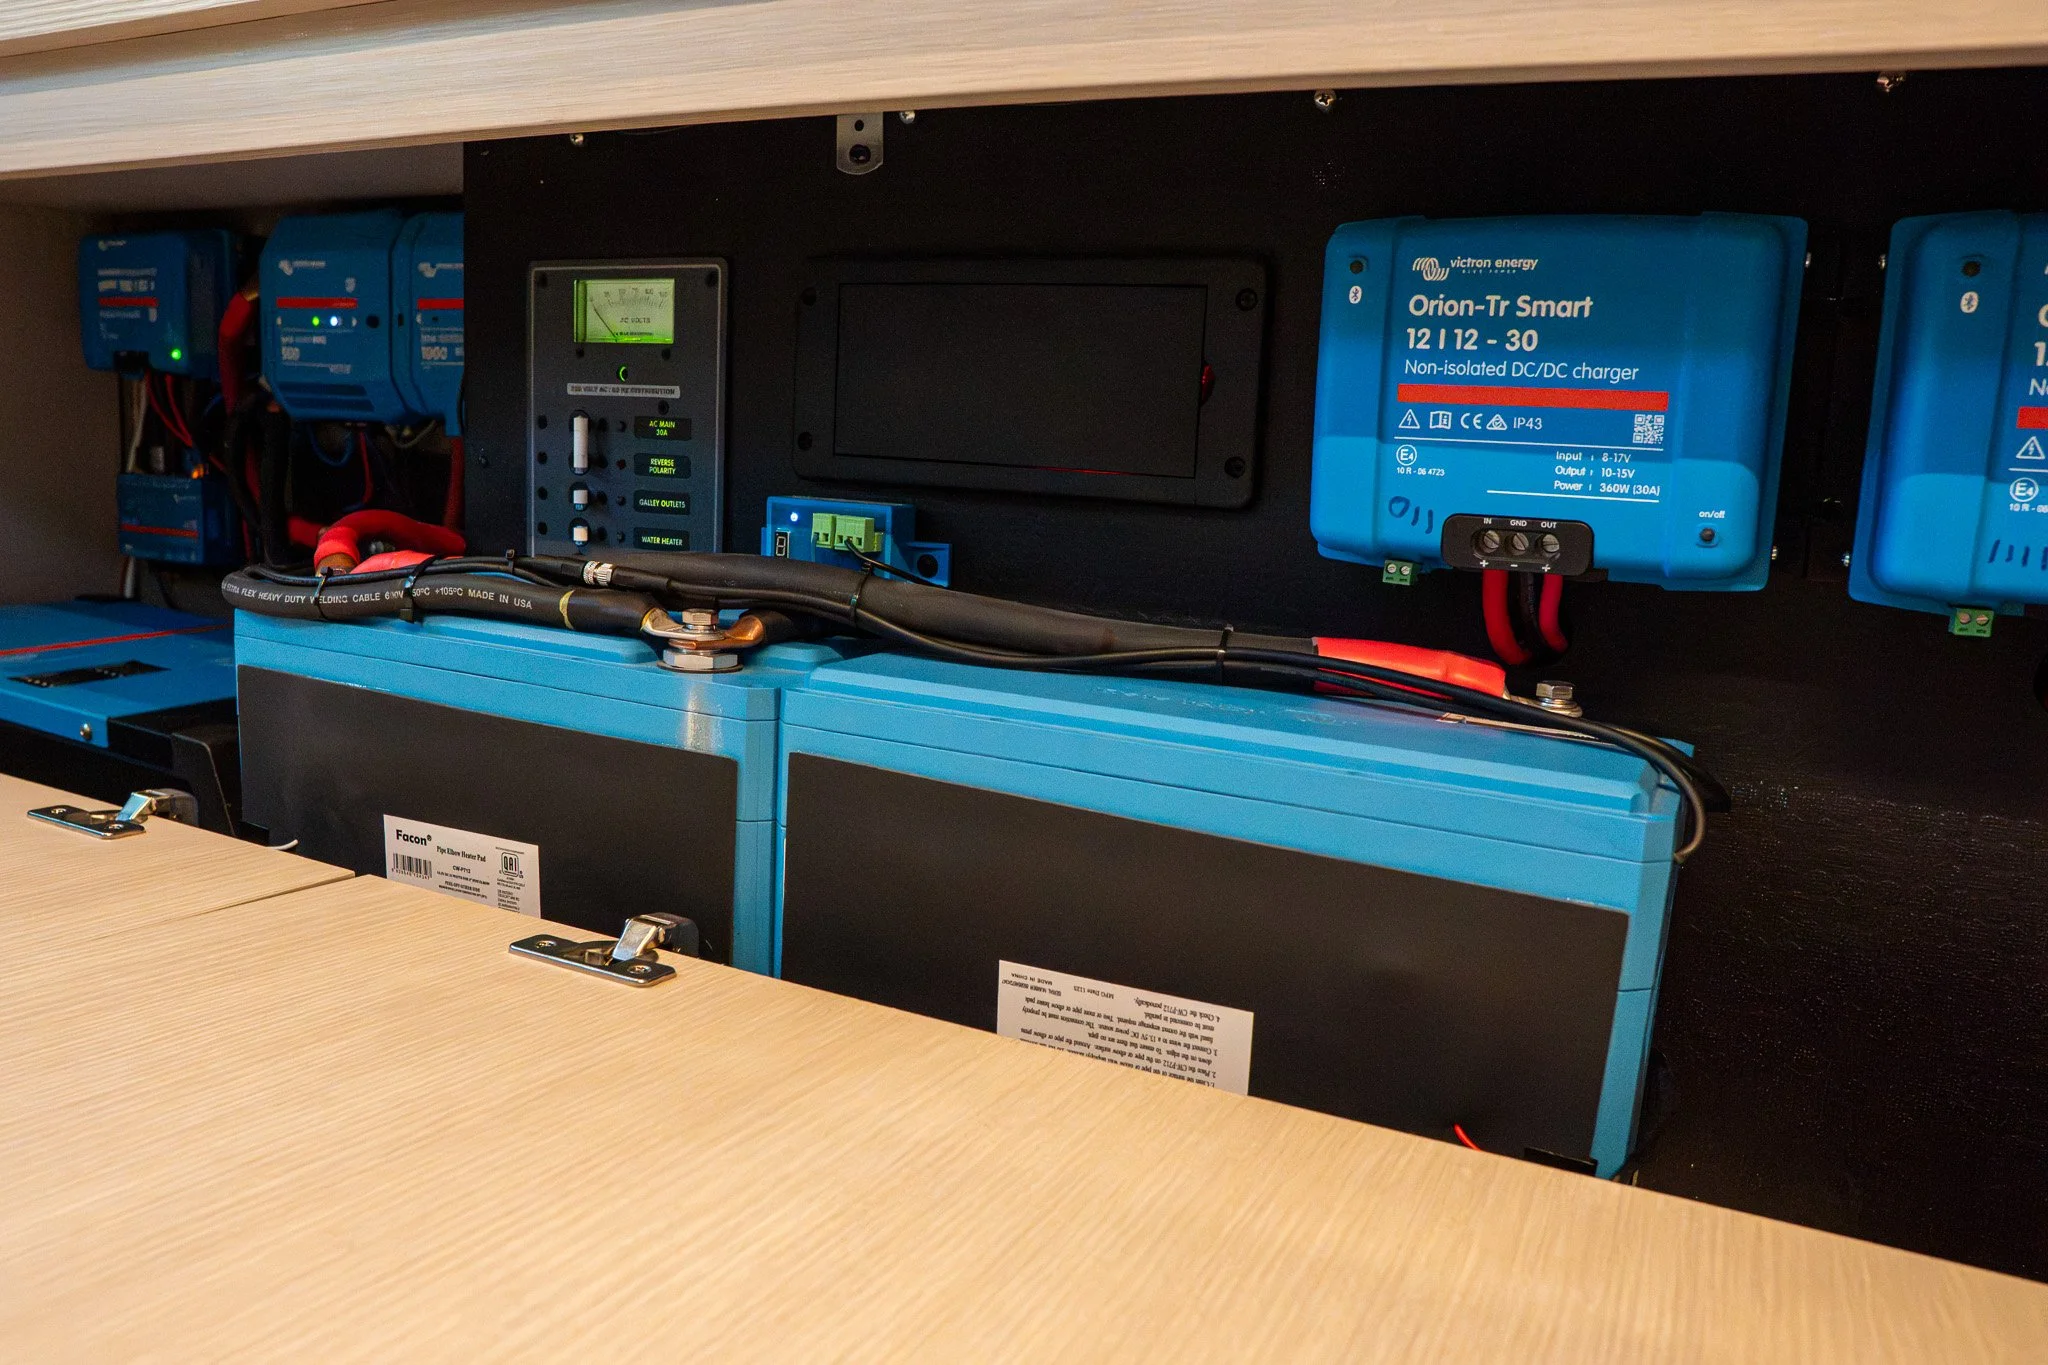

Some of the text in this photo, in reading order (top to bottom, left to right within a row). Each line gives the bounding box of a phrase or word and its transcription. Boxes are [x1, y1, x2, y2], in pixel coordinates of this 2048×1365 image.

[1450, 256, 1539, 271] victron energy
[1409, 293, 1594, 318] Orion-Tr Smart
[1407, 328, 1431, 350] 12
[1454, 328, 1478, 350] 12
[1505, 329, 1539, 352] 30
[2034, 342, 2048, 366] 1
[1405, 359, 1639, 383] Non-isolated DC/DC charger
[1513, 417, 1543, 430] IP43
[1556, 451, 1631, 463] Input 8-17V
[651, 458, 674, 466] REVERSE
[649, 467, 676, 475] POLARITY
[1555, 466, 1635, 478] Output 10-15V
[1554, 480, 1660, 496] Power 360W (30A)
[639, 499, 685, 508] GALLEY OUTLETS
[1699, 510, 1725, 518] on/off
[642, 536, 682, 546] WATER HEATER
[241, 588, 257, 598] FLEX
[258, 592, 283, 602] HEAVY
[284, 594, 306, 604] DUTY
[352, 592, 380, 602] CABLE
[468, 590, 494, 600] MADE
[499, 594, 508, 604] IN
[514, 598, 532, 609] USA
[437, 846, 486, 862] Pipe Elbow Heater Pad
[1037, 978, 1052, 986] MADE
[1022, 1006, 1040, 1015] properly
[1051, 1003, 1064, 1011] elbow
[1072, 1006, 1082, 1014] pipe
[1163, 1005, 1187, 1017] CW-P712
[1061, 1016, 1084, 1025] connection
[1103, 1014, 1114, 1022] Two
[1199, 1012, 1214, 1021] Check
[1086, 1021, 1094, 1029] The
[1138, 1021, 1160, 1031] amperage
[1170, 1017, 1193, 1027] connected
[1162, 1027, 1178, 1035] correct
[1202, 1024, 1214, 1032] must
[1034, 1031, 1047, 1039] elbow
[1074, 1040, 1090, 1049] Around
[1117, 1039, 1128, 1047] there
[1113, 1049, 1126, 1057] elbow
[1192, 1045, 1212, 1055] Connect
[1198, 1057, 1212, 1066] down
[1198, 1068, 1210, 1077] Place
